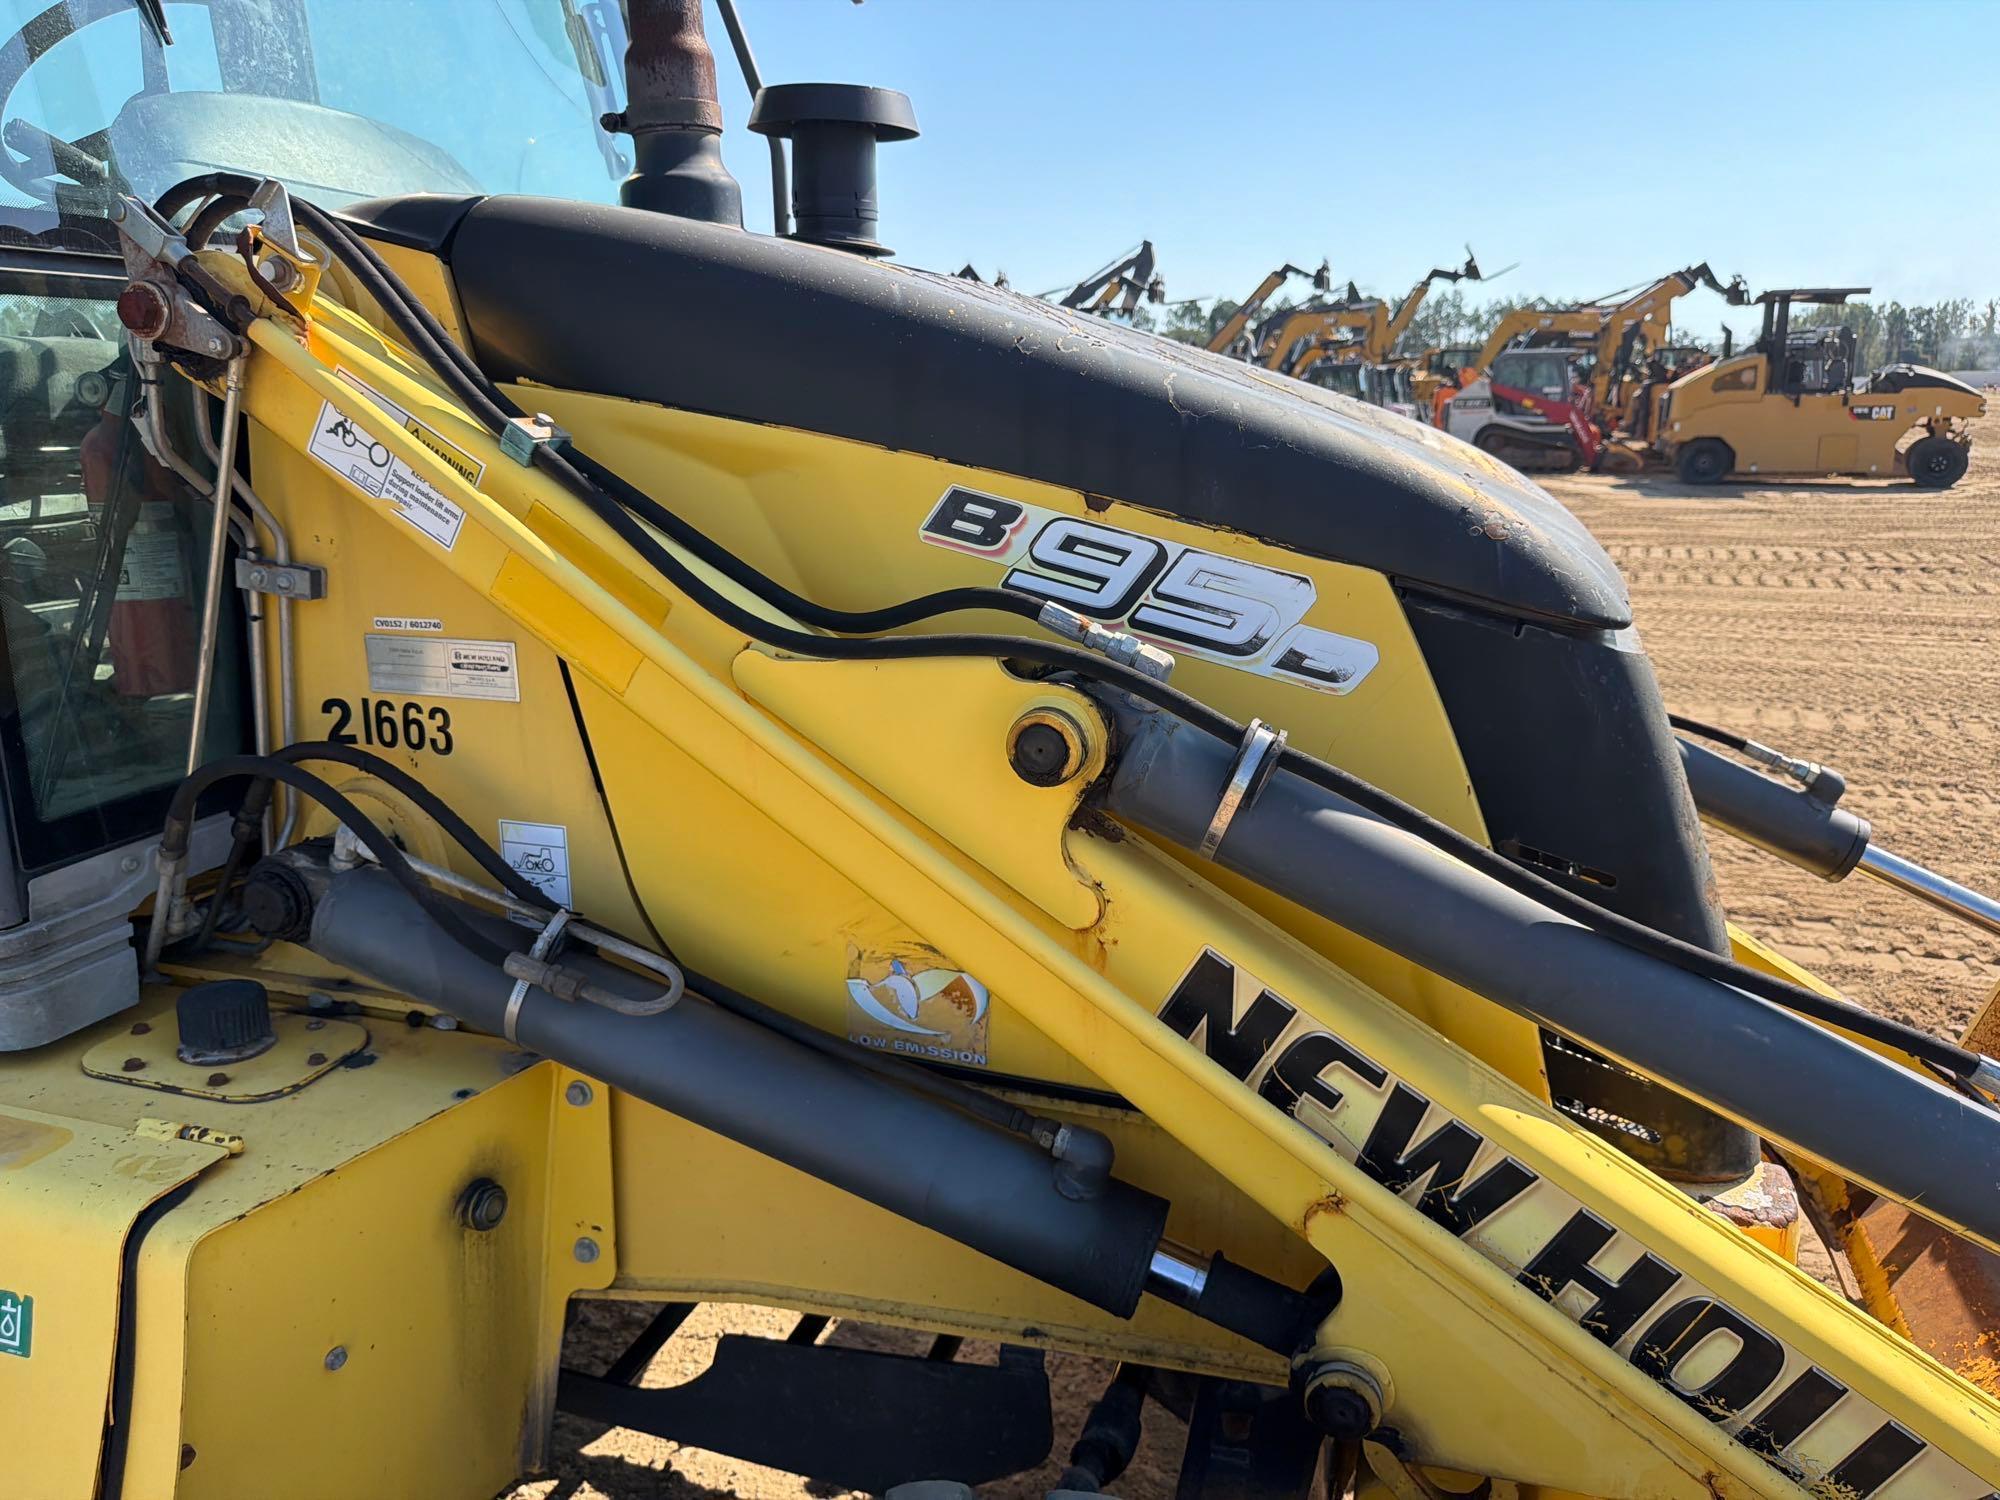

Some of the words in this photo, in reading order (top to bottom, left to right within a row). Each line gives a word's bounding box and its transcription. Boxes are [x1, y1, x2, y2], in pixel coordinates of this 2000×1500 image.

[1872, 406, 1894, 420] CAT
[388, 479, 409, 498] during
[409, 493, 450, 525] maintenance
[391, 469, 415, 490] Support
[415, 485, 434, 503] loader
[434, 499, 444, 510] lift
[444, 507, 459, 521] arms
[375, 619, 402, 628] CV0152
[409, 620, 442, 629] 6012740
[321, 697, 454, 756] 21663
[850, 1034, 887, 1048] LOW
[894, 1039, 987, 1065] EMISSION
[1158, 946, 1540, 1240] NEW
